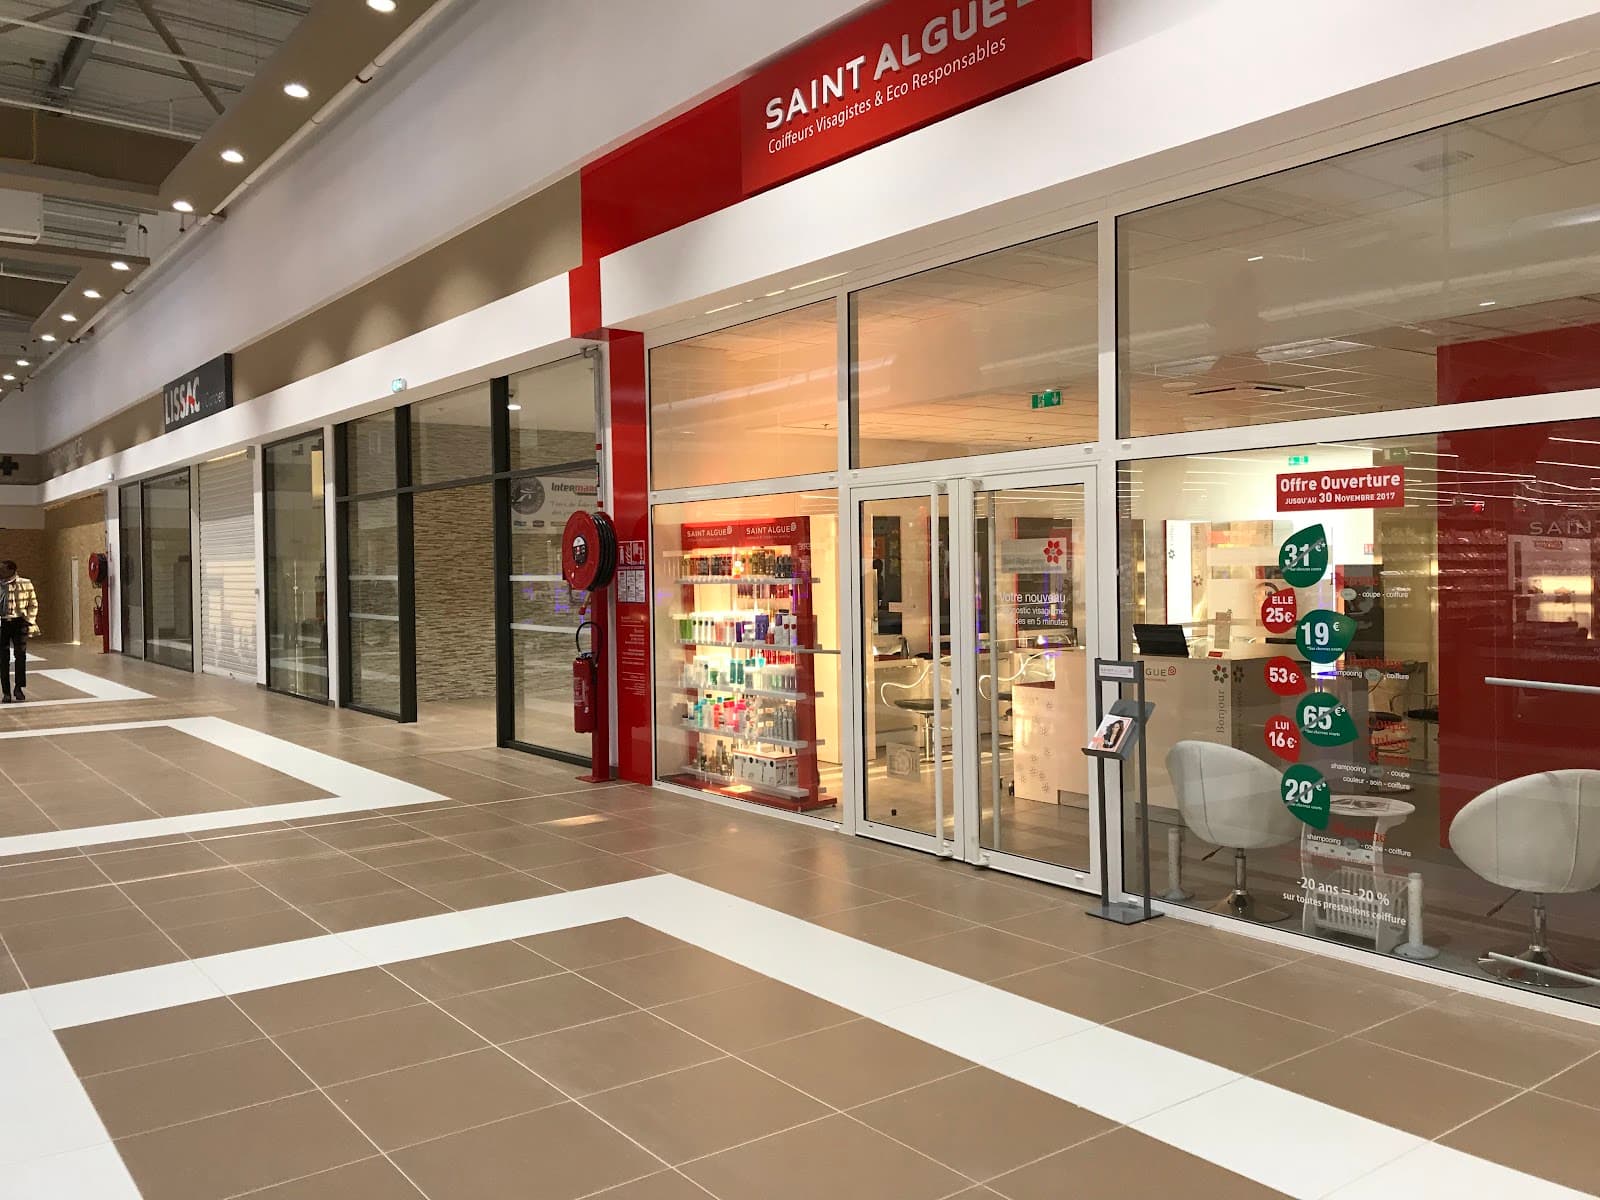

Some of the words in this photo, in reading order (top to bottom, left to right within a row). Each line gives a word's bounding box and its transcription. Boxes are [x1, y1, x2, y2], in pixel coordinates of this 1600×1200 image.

[766, 55, 867, 130] SAINT
[873, 0, 1008, 81] ALGUE
[768, 122, 814, 154] Coiffeurs
[816, 97, 872, 132] Visagistes
[874, 89, 884, 107] &
[886, 80, 909, 102] Eco
[911, 36, 1006, 91] Responsables
[165, 376, 201, 425] LISSAC
[1280, 478, 1317, 492] Offre
[1321, 474, 1401, 491] Ouverture
[1285, 496, 1317, 505] JUSQU'AU
[1318, 491, 1333, 503] 30
[1376, 491, 1396, 501] 2017
[686, 529, 705, 538] SAINT
[706, 528, 728, 537] ALGUE
[746, 526, 766, 535] SAINT
[767, 524, 791, 534] ALGUE
[1284, 543, 1310, 567] 31
[999, 592, 1022, 602] Votre
[1025, 593, 1066, 603] nouveau
[1271, 596, 1294, 605] ELLE
[1036, 617, 1041, 625] 5
[1042, 618, 1069, 627] minutes
[1301, 622, 1329, 646] 19
[1145, 667, 1167, 677] GUE
[1275, 720, 1290, 731] LUI
[1303, 705, 1333, 730] 65
[1330, 762, 1367, 774] shampooing
[1390, 770, 1410, 779] coupe
[1342, 775, 1364, 785] couleur
[1285, 779, 1314, 804] 20
[1306, 832, 1341, 846] shampooing
[1297, 876, 1315, 891] -20
[1318, 884, 1339, 896] ans
[1353, 888, 1374, 902] -20
[1377, 892, 1390, 906] %
[1282, 892, 1295, 902] sur
[1296, 894, 1322, 908] toutes
[1323, 900, 1370, 919] prestations
[1370, 908, 1407, 926] coiffure
